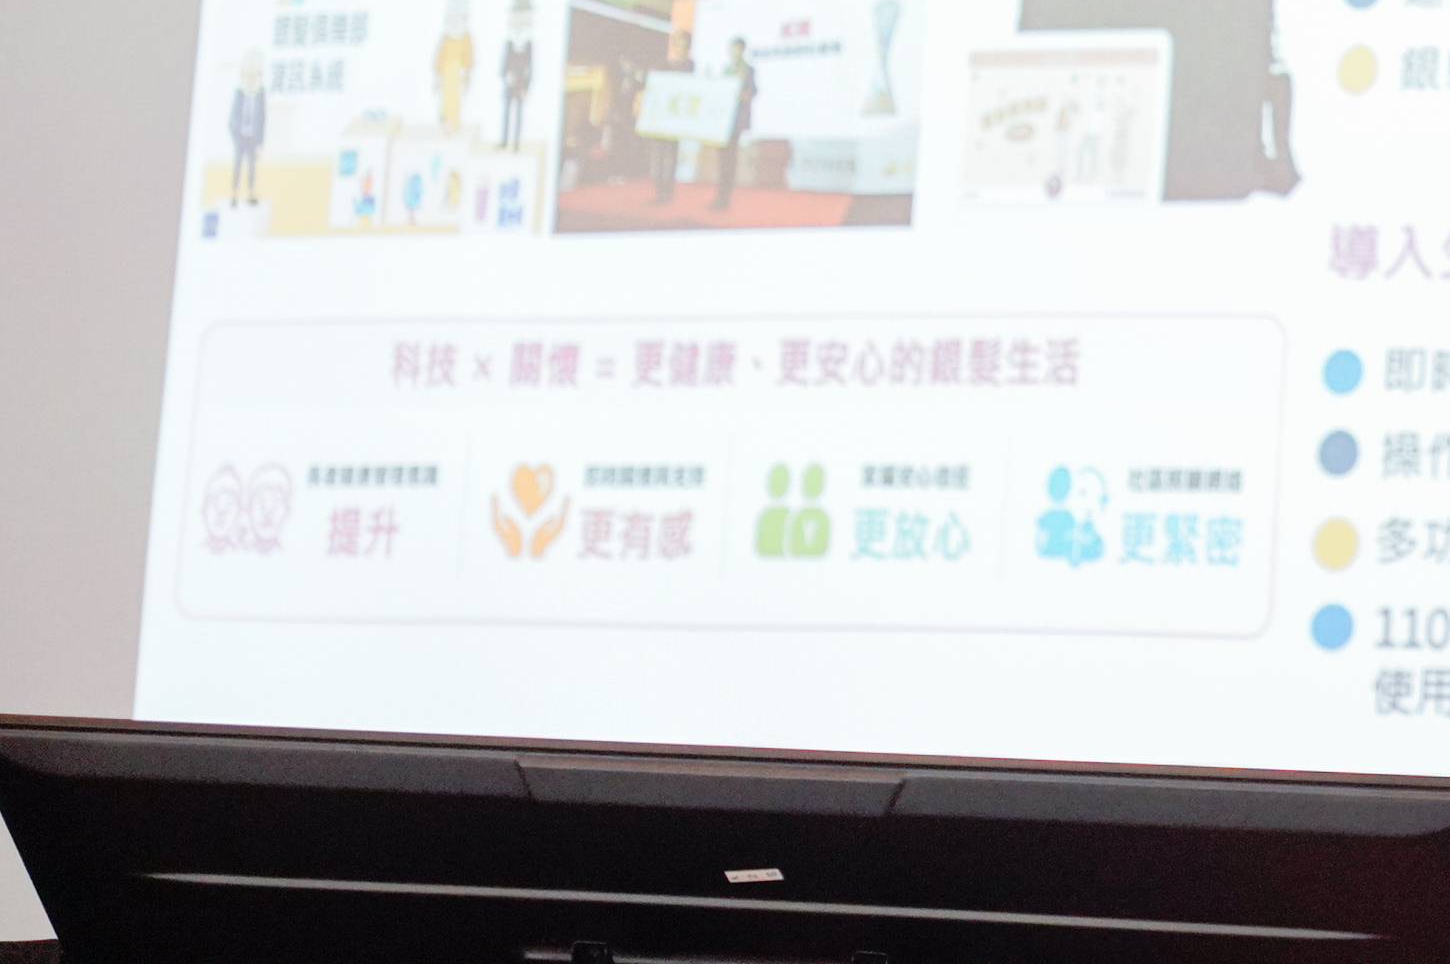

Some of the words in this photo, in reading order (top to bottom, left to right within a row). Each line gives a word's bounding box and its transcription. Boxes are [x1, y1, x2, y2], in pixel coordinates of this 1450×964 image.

[389, 340, 459, 388] 科技
[325, 505, 401, 558] 提升
[576, 507, 695, 562] 更有感
[849, 506, 972, 562] 更放心
[1117, 511, 1244, 568] 更緊密
